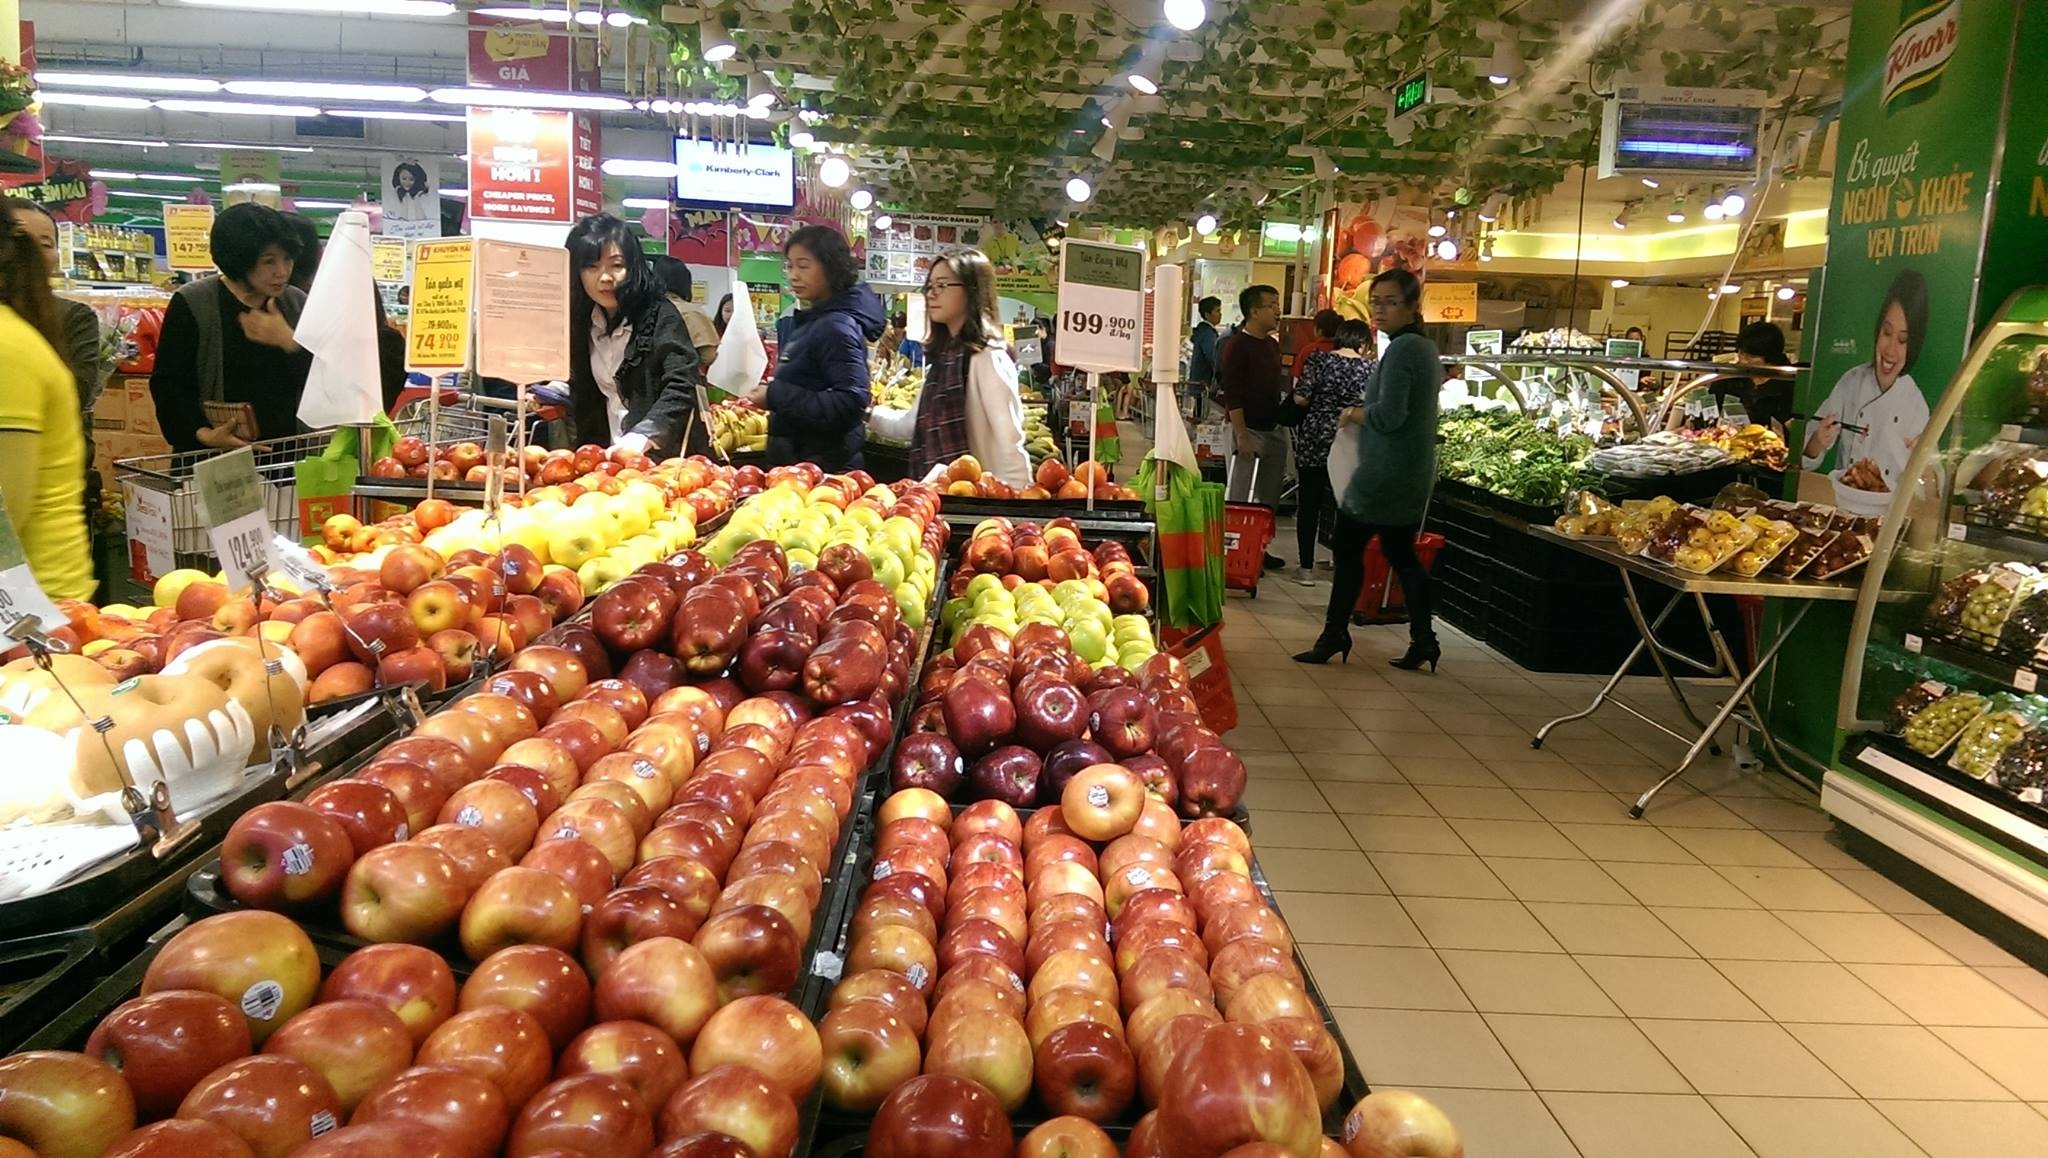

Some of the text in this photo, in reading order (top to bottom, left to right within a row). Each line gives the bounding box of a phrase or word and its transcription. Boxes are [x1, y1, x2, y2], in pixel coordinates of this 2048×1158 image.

[1887, 17, 1958, 85] Knorr
[499, 64, 530, 80] GIÁ
[705, 164, 781, 178] Kimberly-Clark
[1872, 139, 1920, 188] quyết
[483, 191, 525, 200] CHEAPER
[1841, 184, 1891, 226] NGON
[1917, 163, 1974, 217] KHỎE
[483, 203, 509, 212] MORE
[511, 204, 550, 214] SAVINGS
[172, 242, 193, 252] 147
[1868, 227, 1896, 265] VẸN
[1063, 310, 1103, 335] 199
[415, 333, 436, 350] 74
